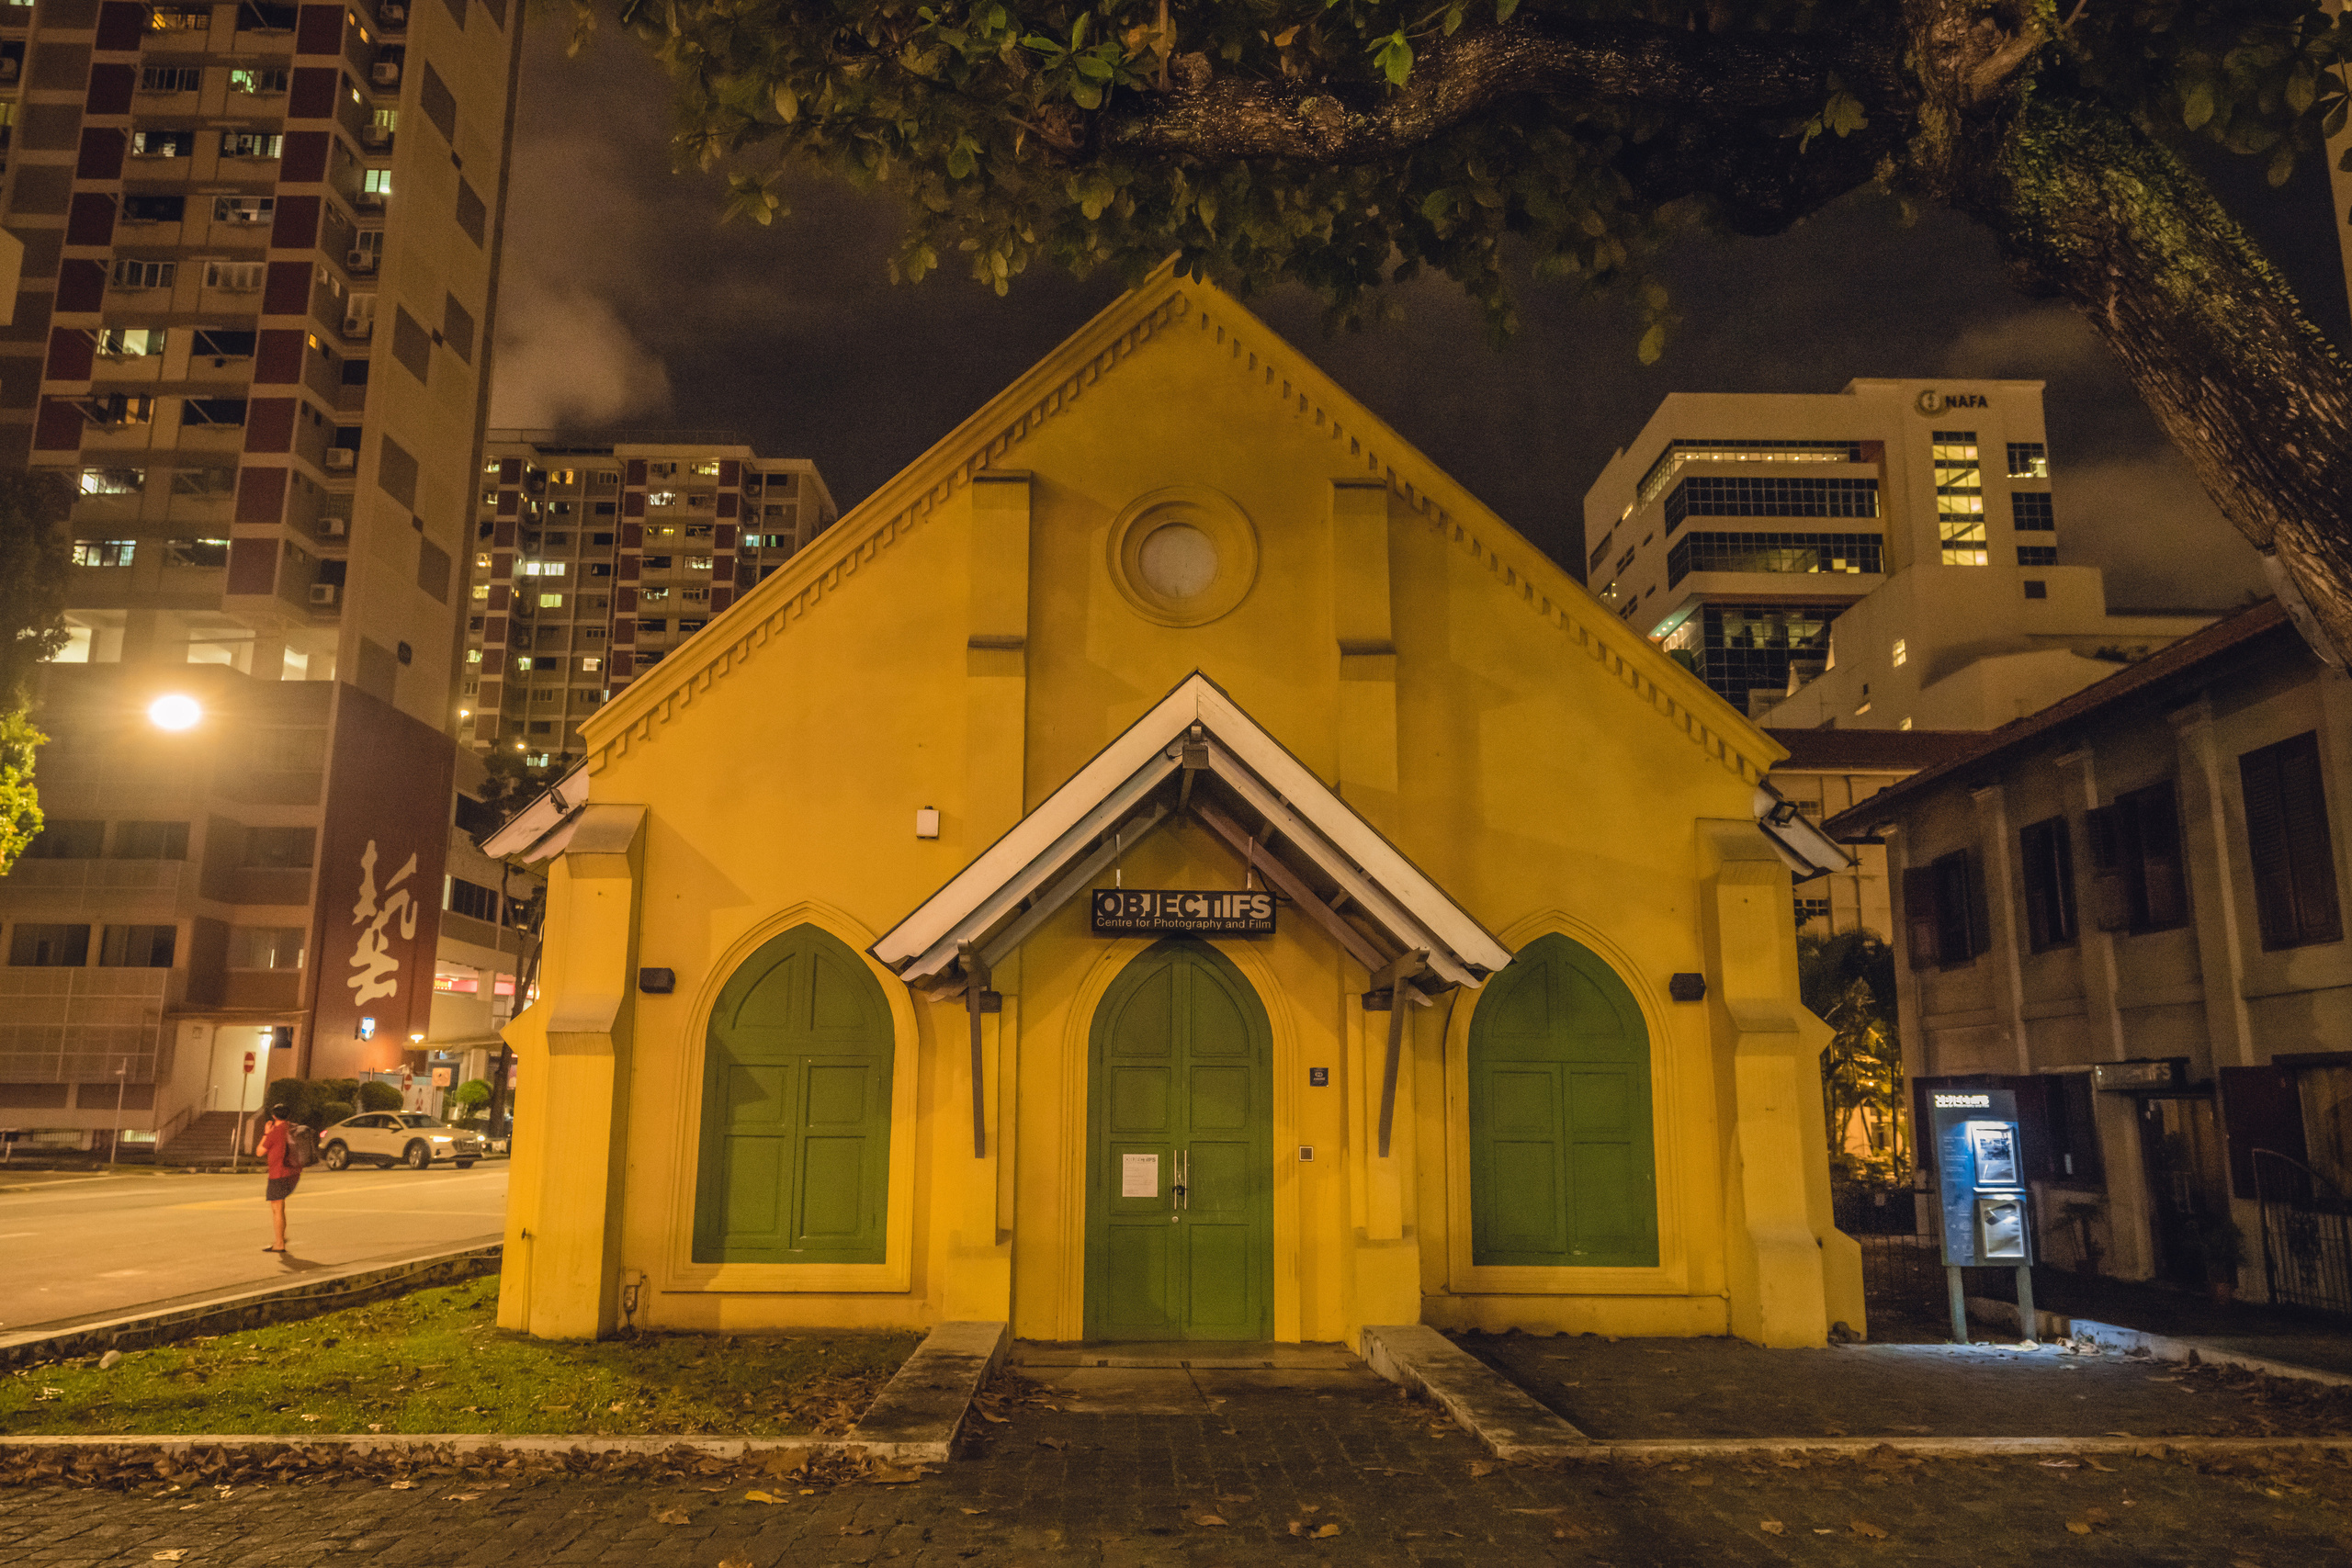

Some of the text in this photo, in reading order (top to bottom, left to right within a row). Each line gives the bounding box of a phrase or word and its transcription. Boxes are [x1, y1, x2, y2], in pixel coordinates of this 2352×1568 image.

[1945, 395, 1988, 408] NAFA
[1097, 893, 1272, 919] OBJECTIFS
[1096, 918, 1272, 931] Centre for Photography and Film
